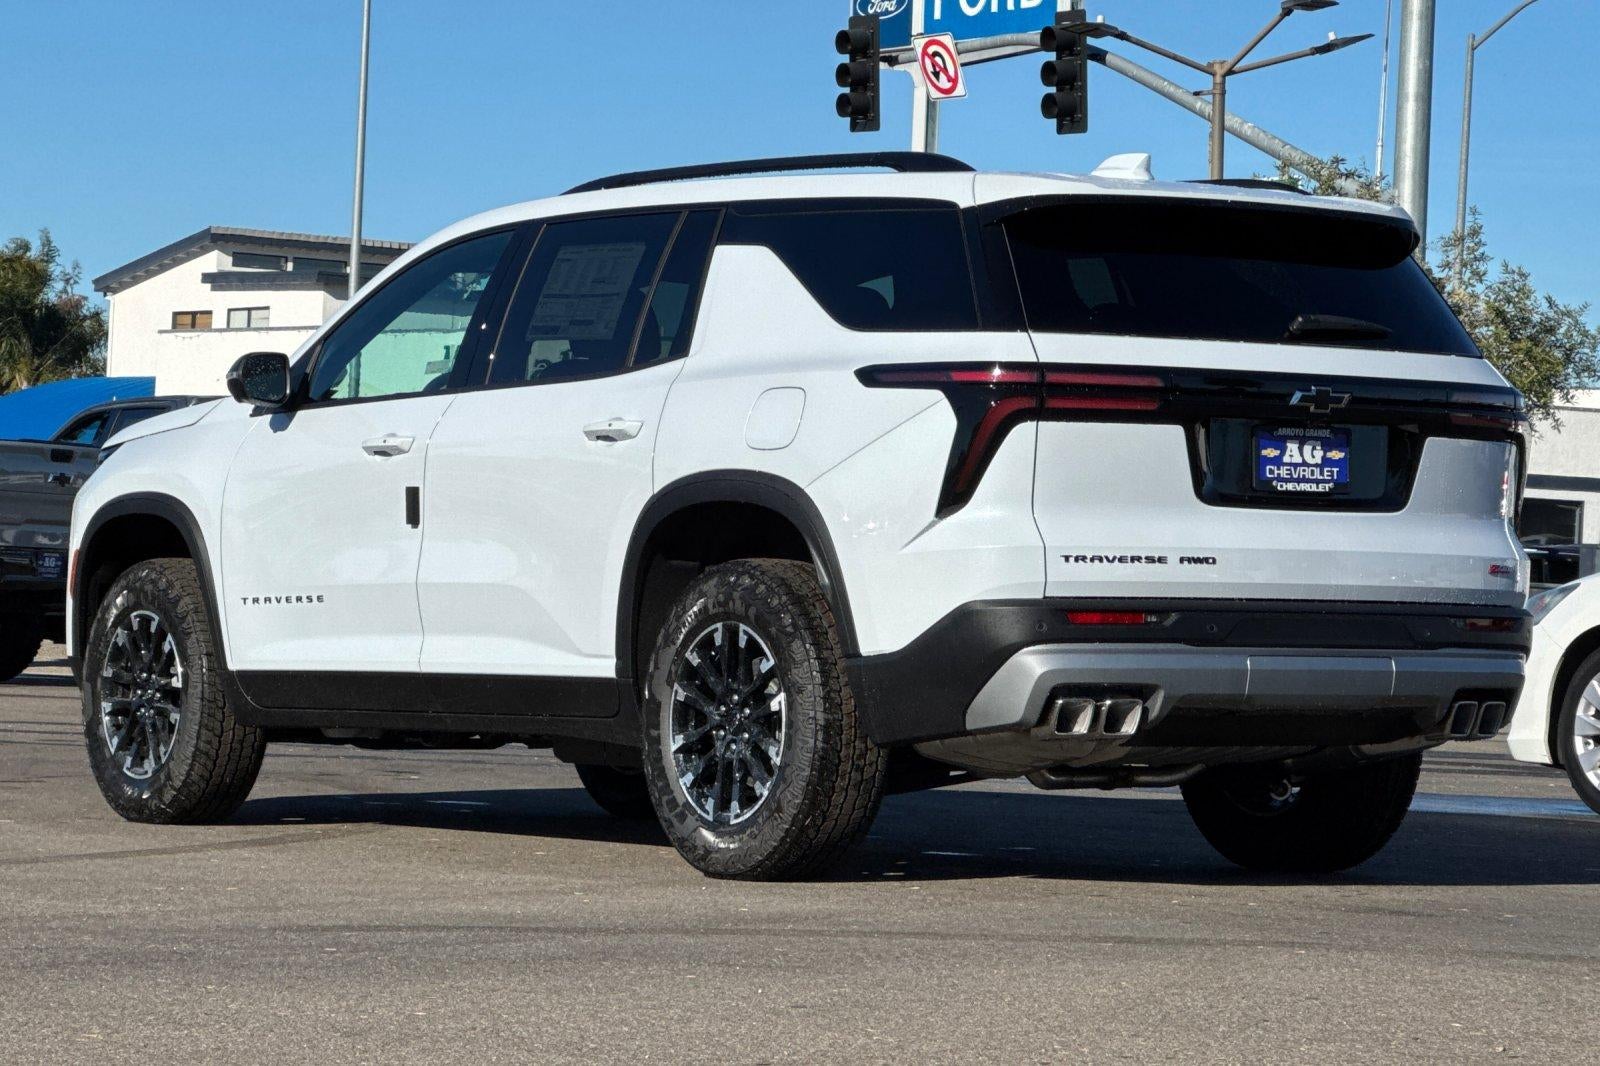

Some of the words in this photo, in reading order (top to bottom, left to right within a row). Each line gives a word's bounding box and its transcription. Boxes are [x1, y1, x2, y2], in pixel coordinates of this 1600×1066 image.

[1276, 427, 1304, 437] ARROYO
[1305, 428, 1331, 437] GRANDE
[1283, 440, 1324, 465] AG
[1265, 465, 1339, 480] CHEVROLET
[1277, 482, 1330, 492] CHEVROLET
[1060, 554, 1168, 564] TRAVERSE
[1179, 556, 1217, 565] AWD
[240, 594, 324, 606] TRAVERSE
